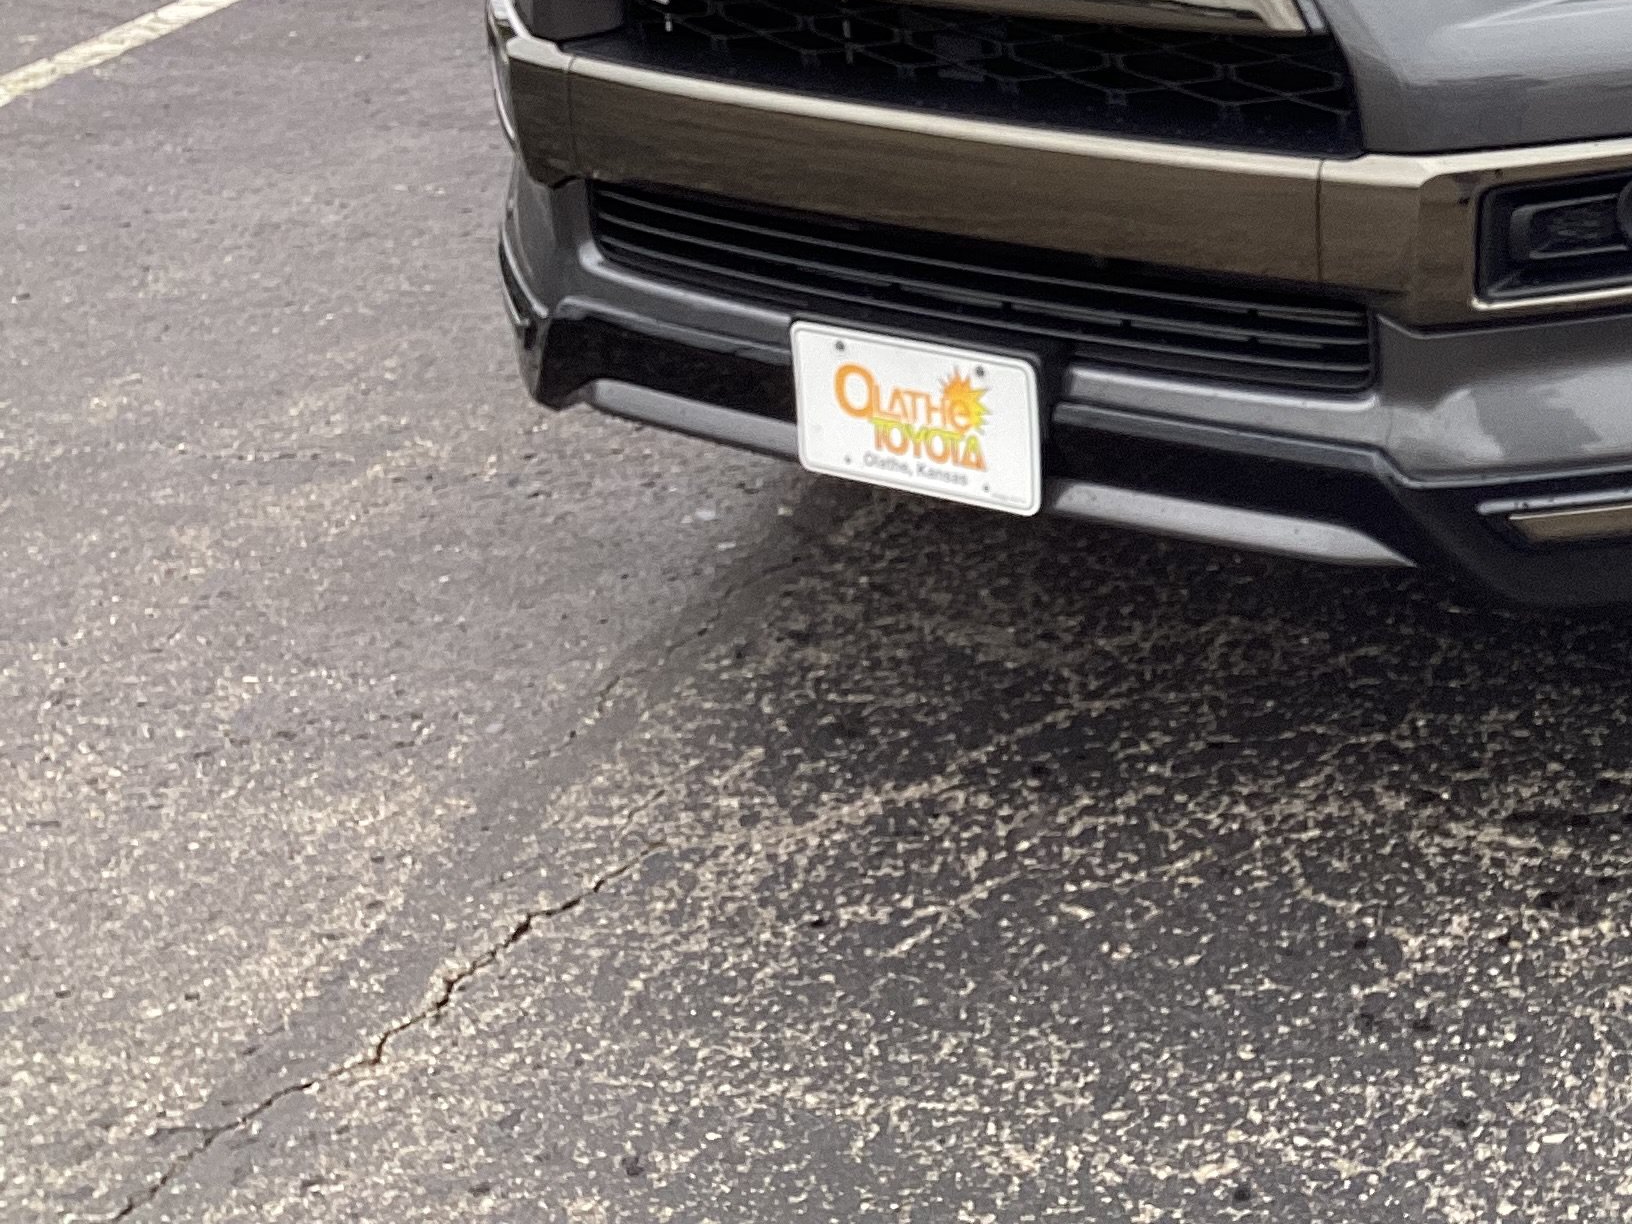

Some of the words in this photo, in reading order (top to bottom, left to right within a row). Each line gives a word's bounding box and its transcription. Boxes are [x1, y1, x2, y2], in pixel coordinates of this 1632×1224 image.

[871, 416, 987, 471] TOYOTA
[862, 451, 913, 477] Olathe,
[916, 462, 969, 486] Kansas
